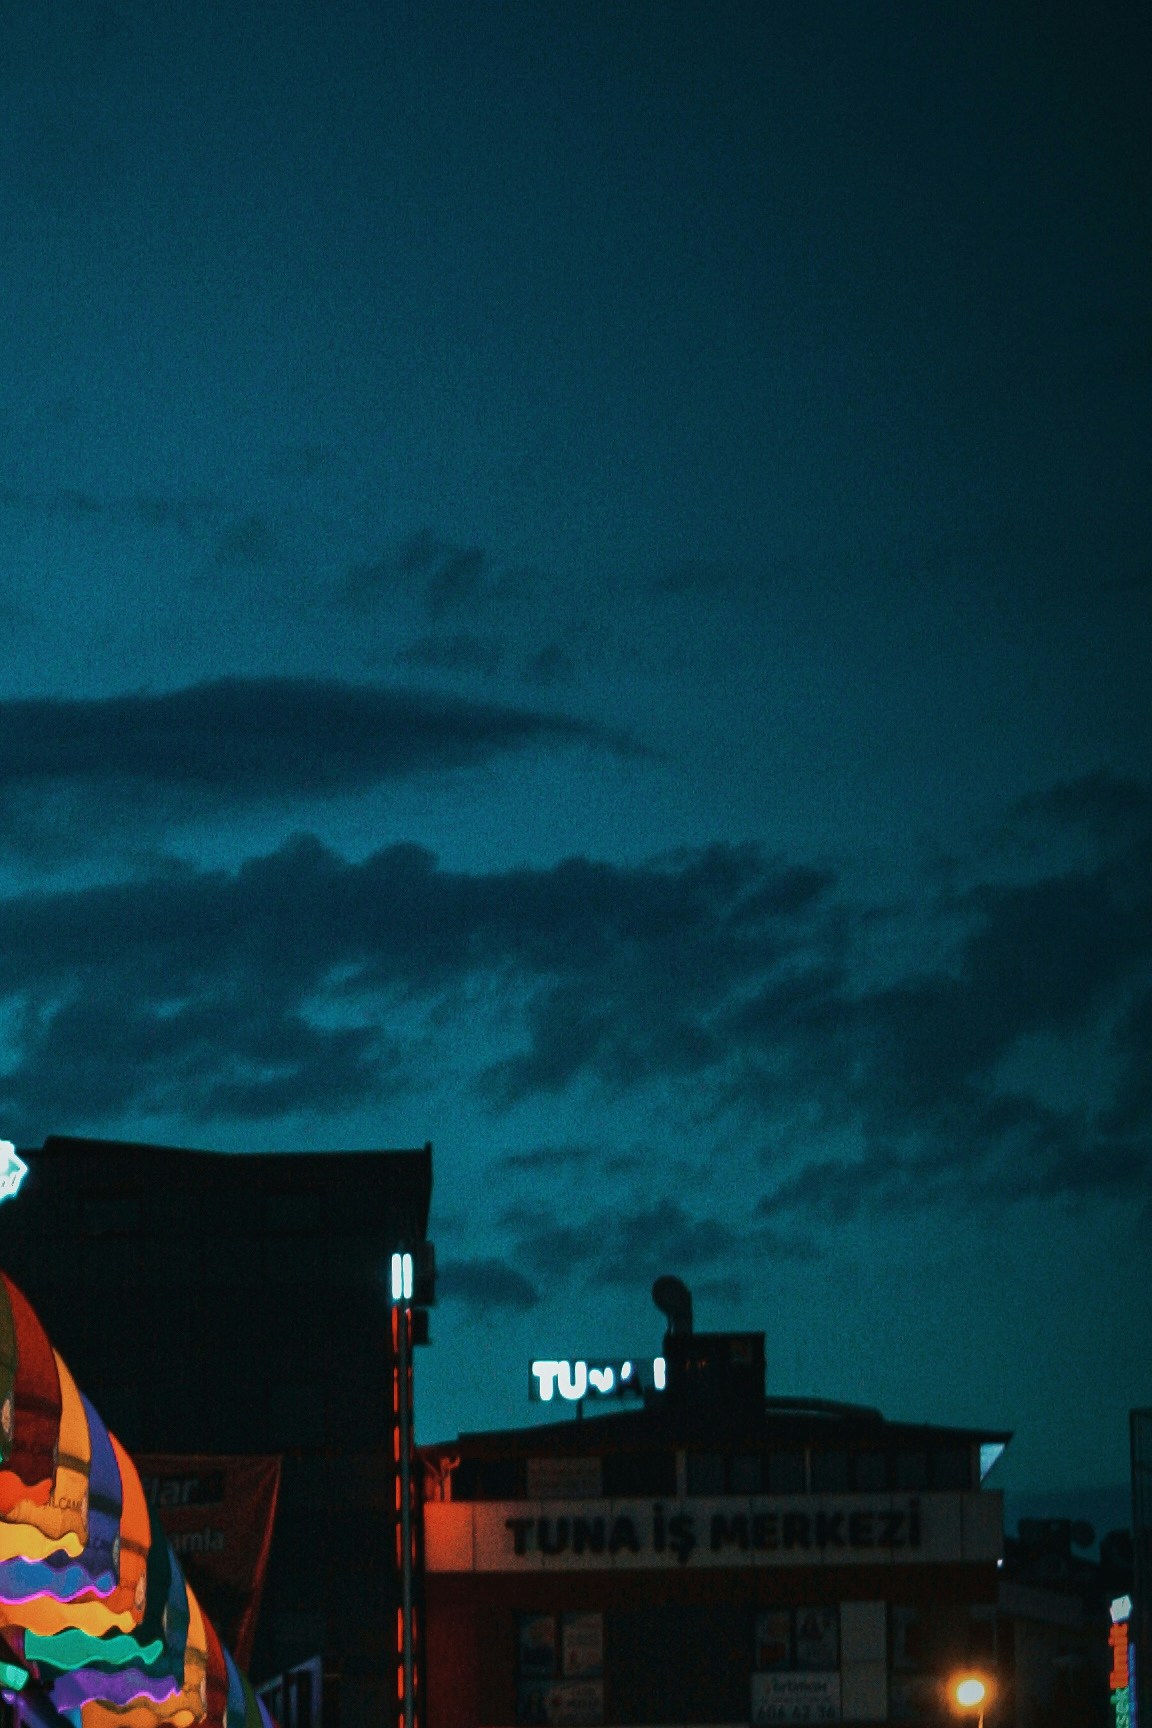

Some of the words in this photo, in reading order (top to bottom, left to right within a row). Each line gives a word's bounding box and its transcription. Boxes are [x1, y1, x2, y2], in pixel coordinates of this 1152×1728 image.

[506, 1515, 639, 1557] TUNA
[652, 1502, 697, 1566] İŞ
[710, 1500, 920, 1553] MERKEZİ
